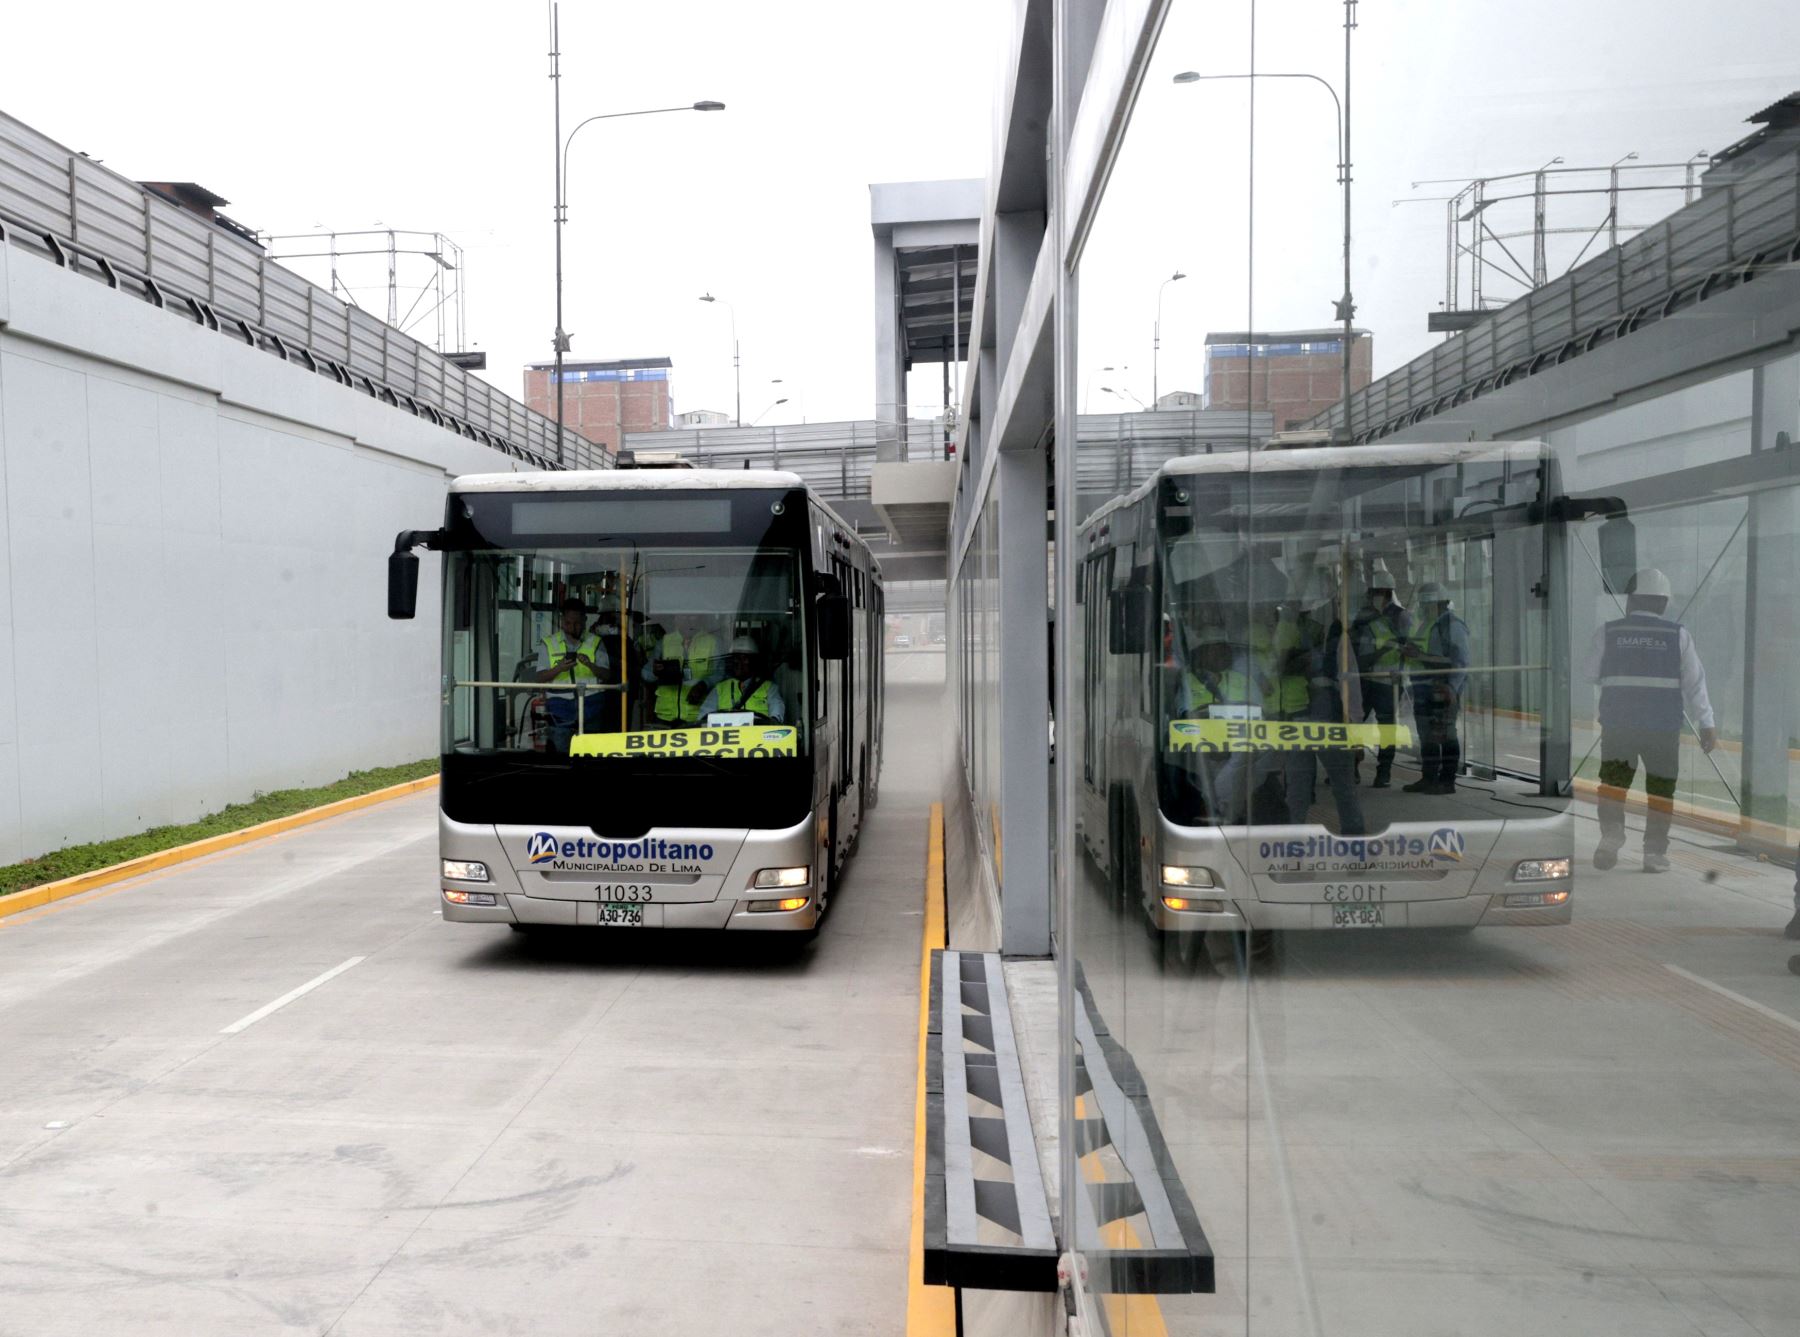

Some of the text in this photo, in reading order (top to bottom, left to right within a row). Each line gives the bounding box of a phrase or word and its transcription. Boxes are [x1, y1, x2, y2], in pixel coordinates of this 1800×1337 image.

[1616, 636, 1653, 646] EMAPE
[625, 729, 740, 749] BUS DE
[527, 832, 714, 865] Metropolitano
[594, 885, 653, 902] 11033
[599, 909, 641, 923] A3Q-736
